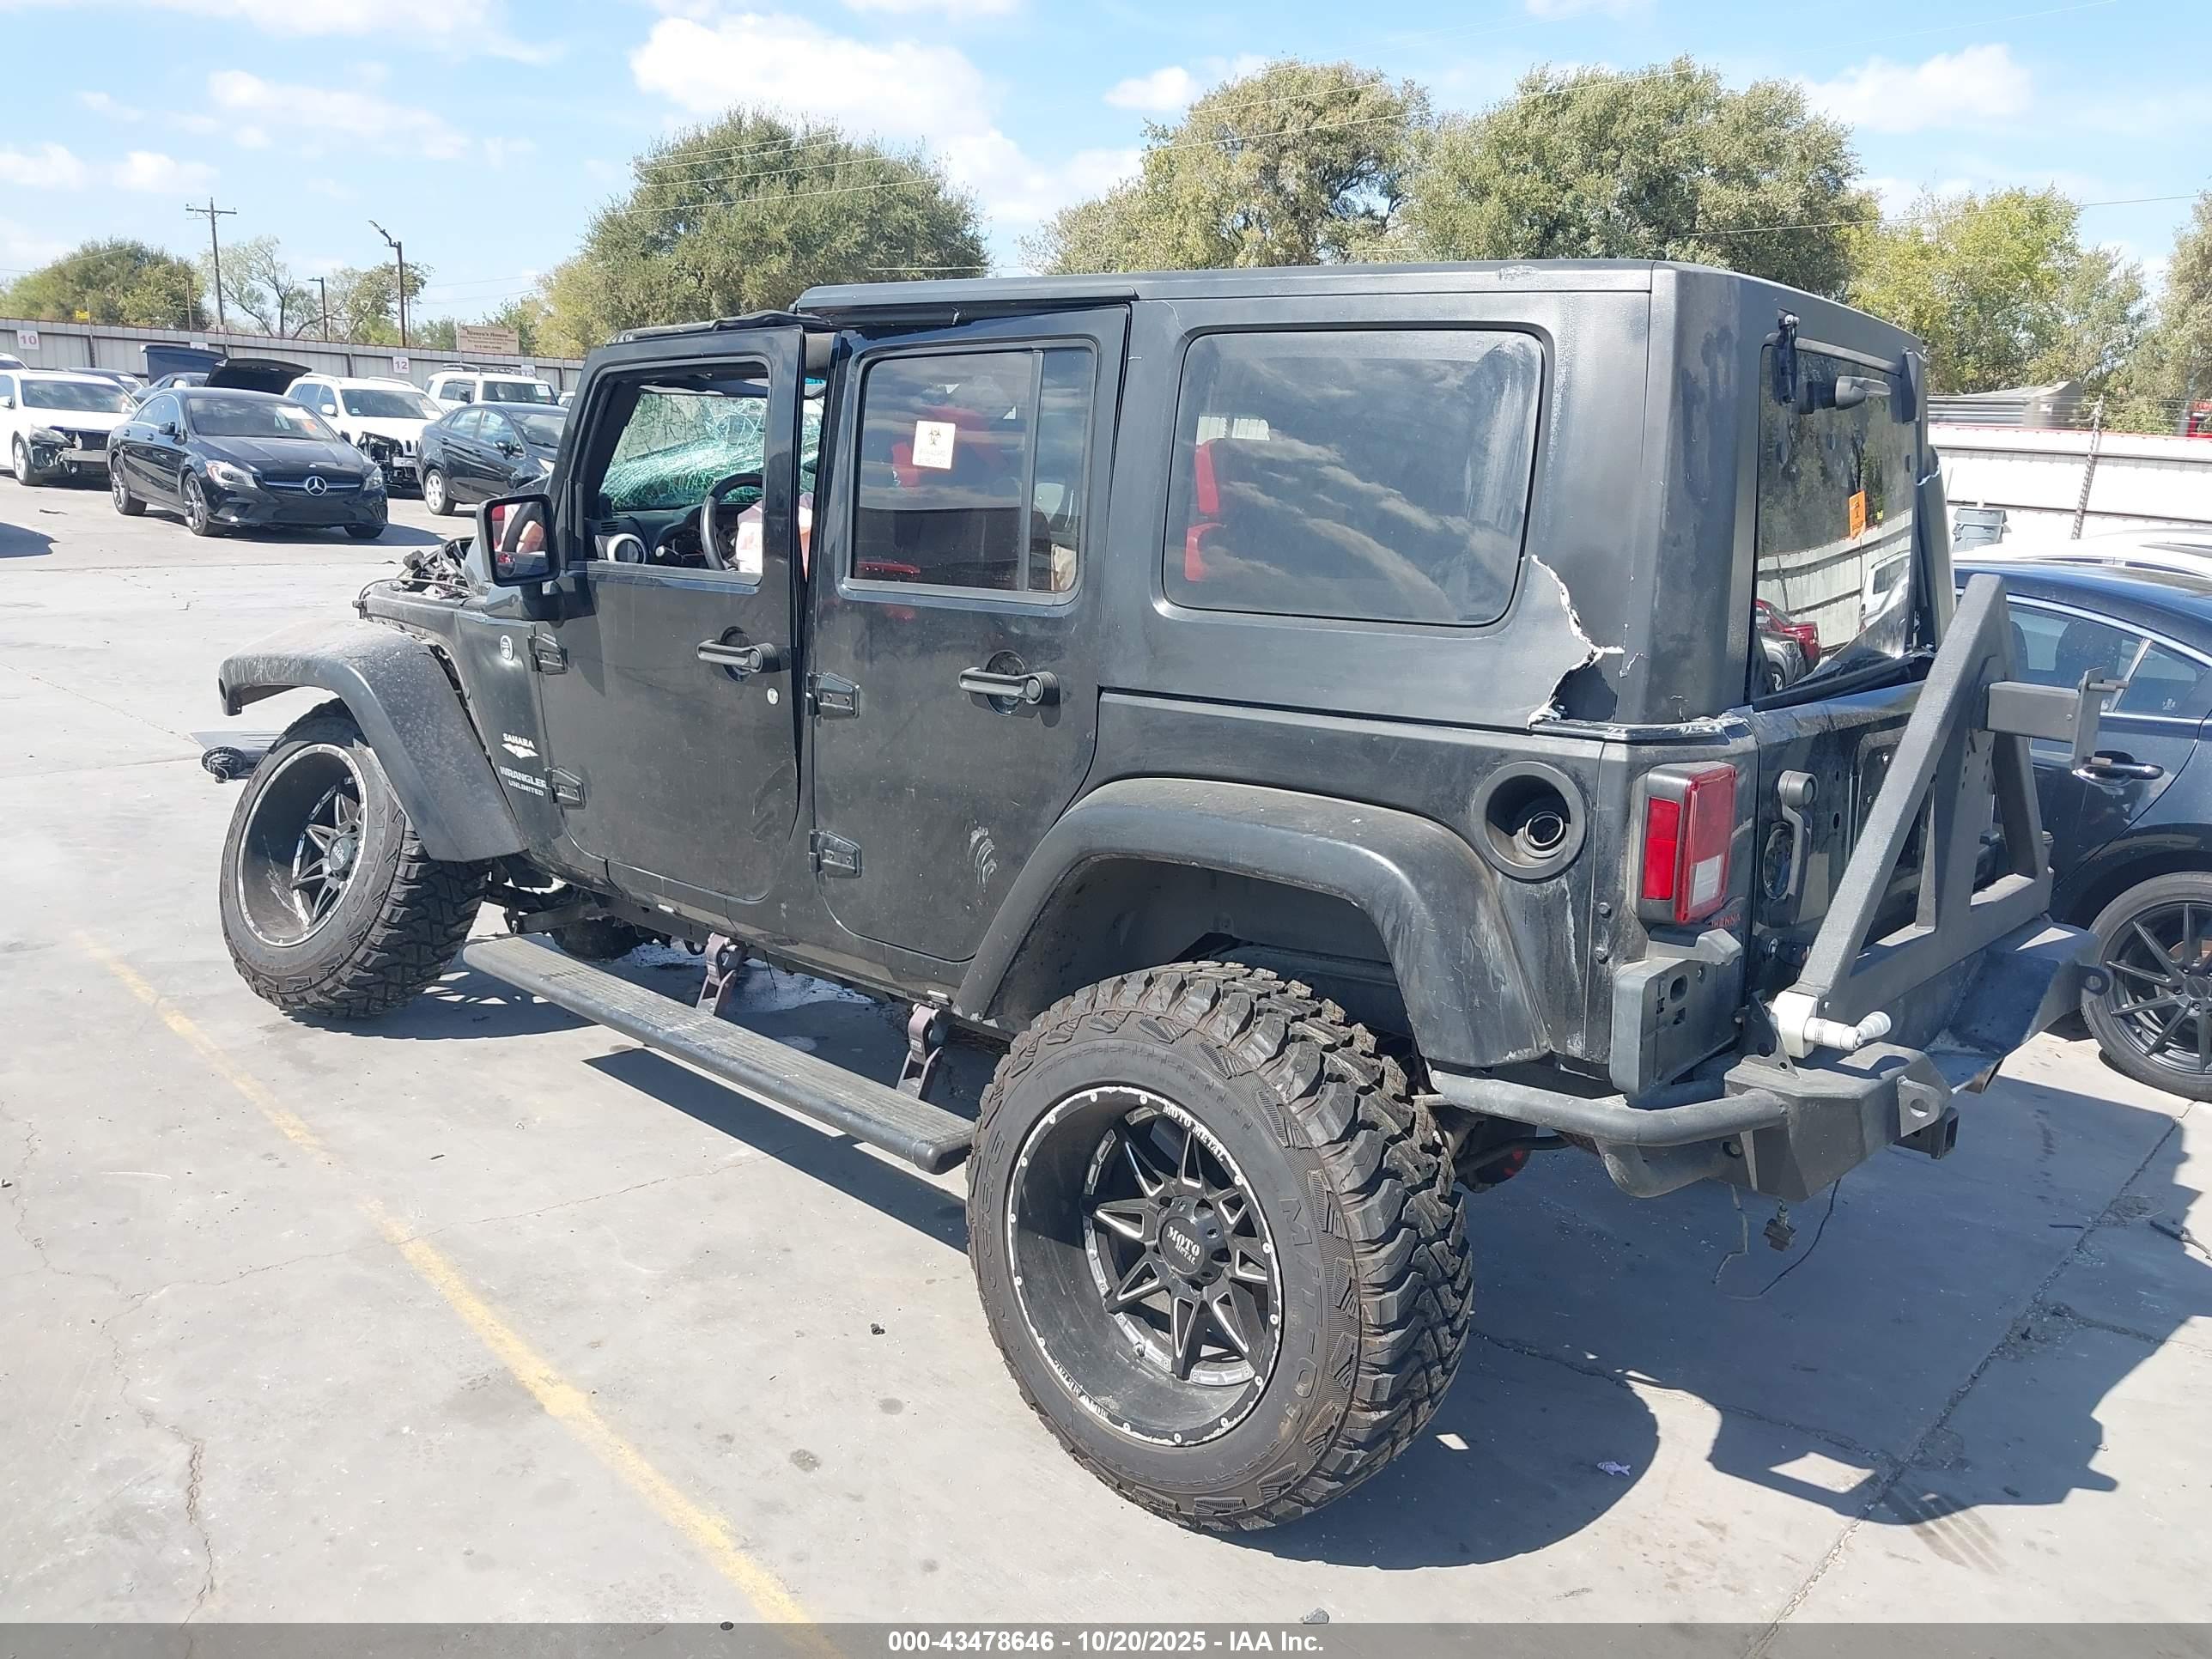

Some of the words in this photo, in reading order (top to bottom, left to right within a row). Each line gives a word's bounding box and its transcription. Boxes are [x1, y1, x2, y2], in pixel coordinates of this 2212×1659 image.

[20, 335, 37, 344] 10
[395, 361, 408, 369] 12
[502, 732, 535, 750] SAHARA
[499, 765, 548, 789] WRANGLER
[507, 779, 544, 796] UNLIMITED
[1163, 1102, 1193, 1127] MOTO
[1167, 1225, 1200, 1256] MOTO
[1175, 1243, 1196, 1265] METAL
